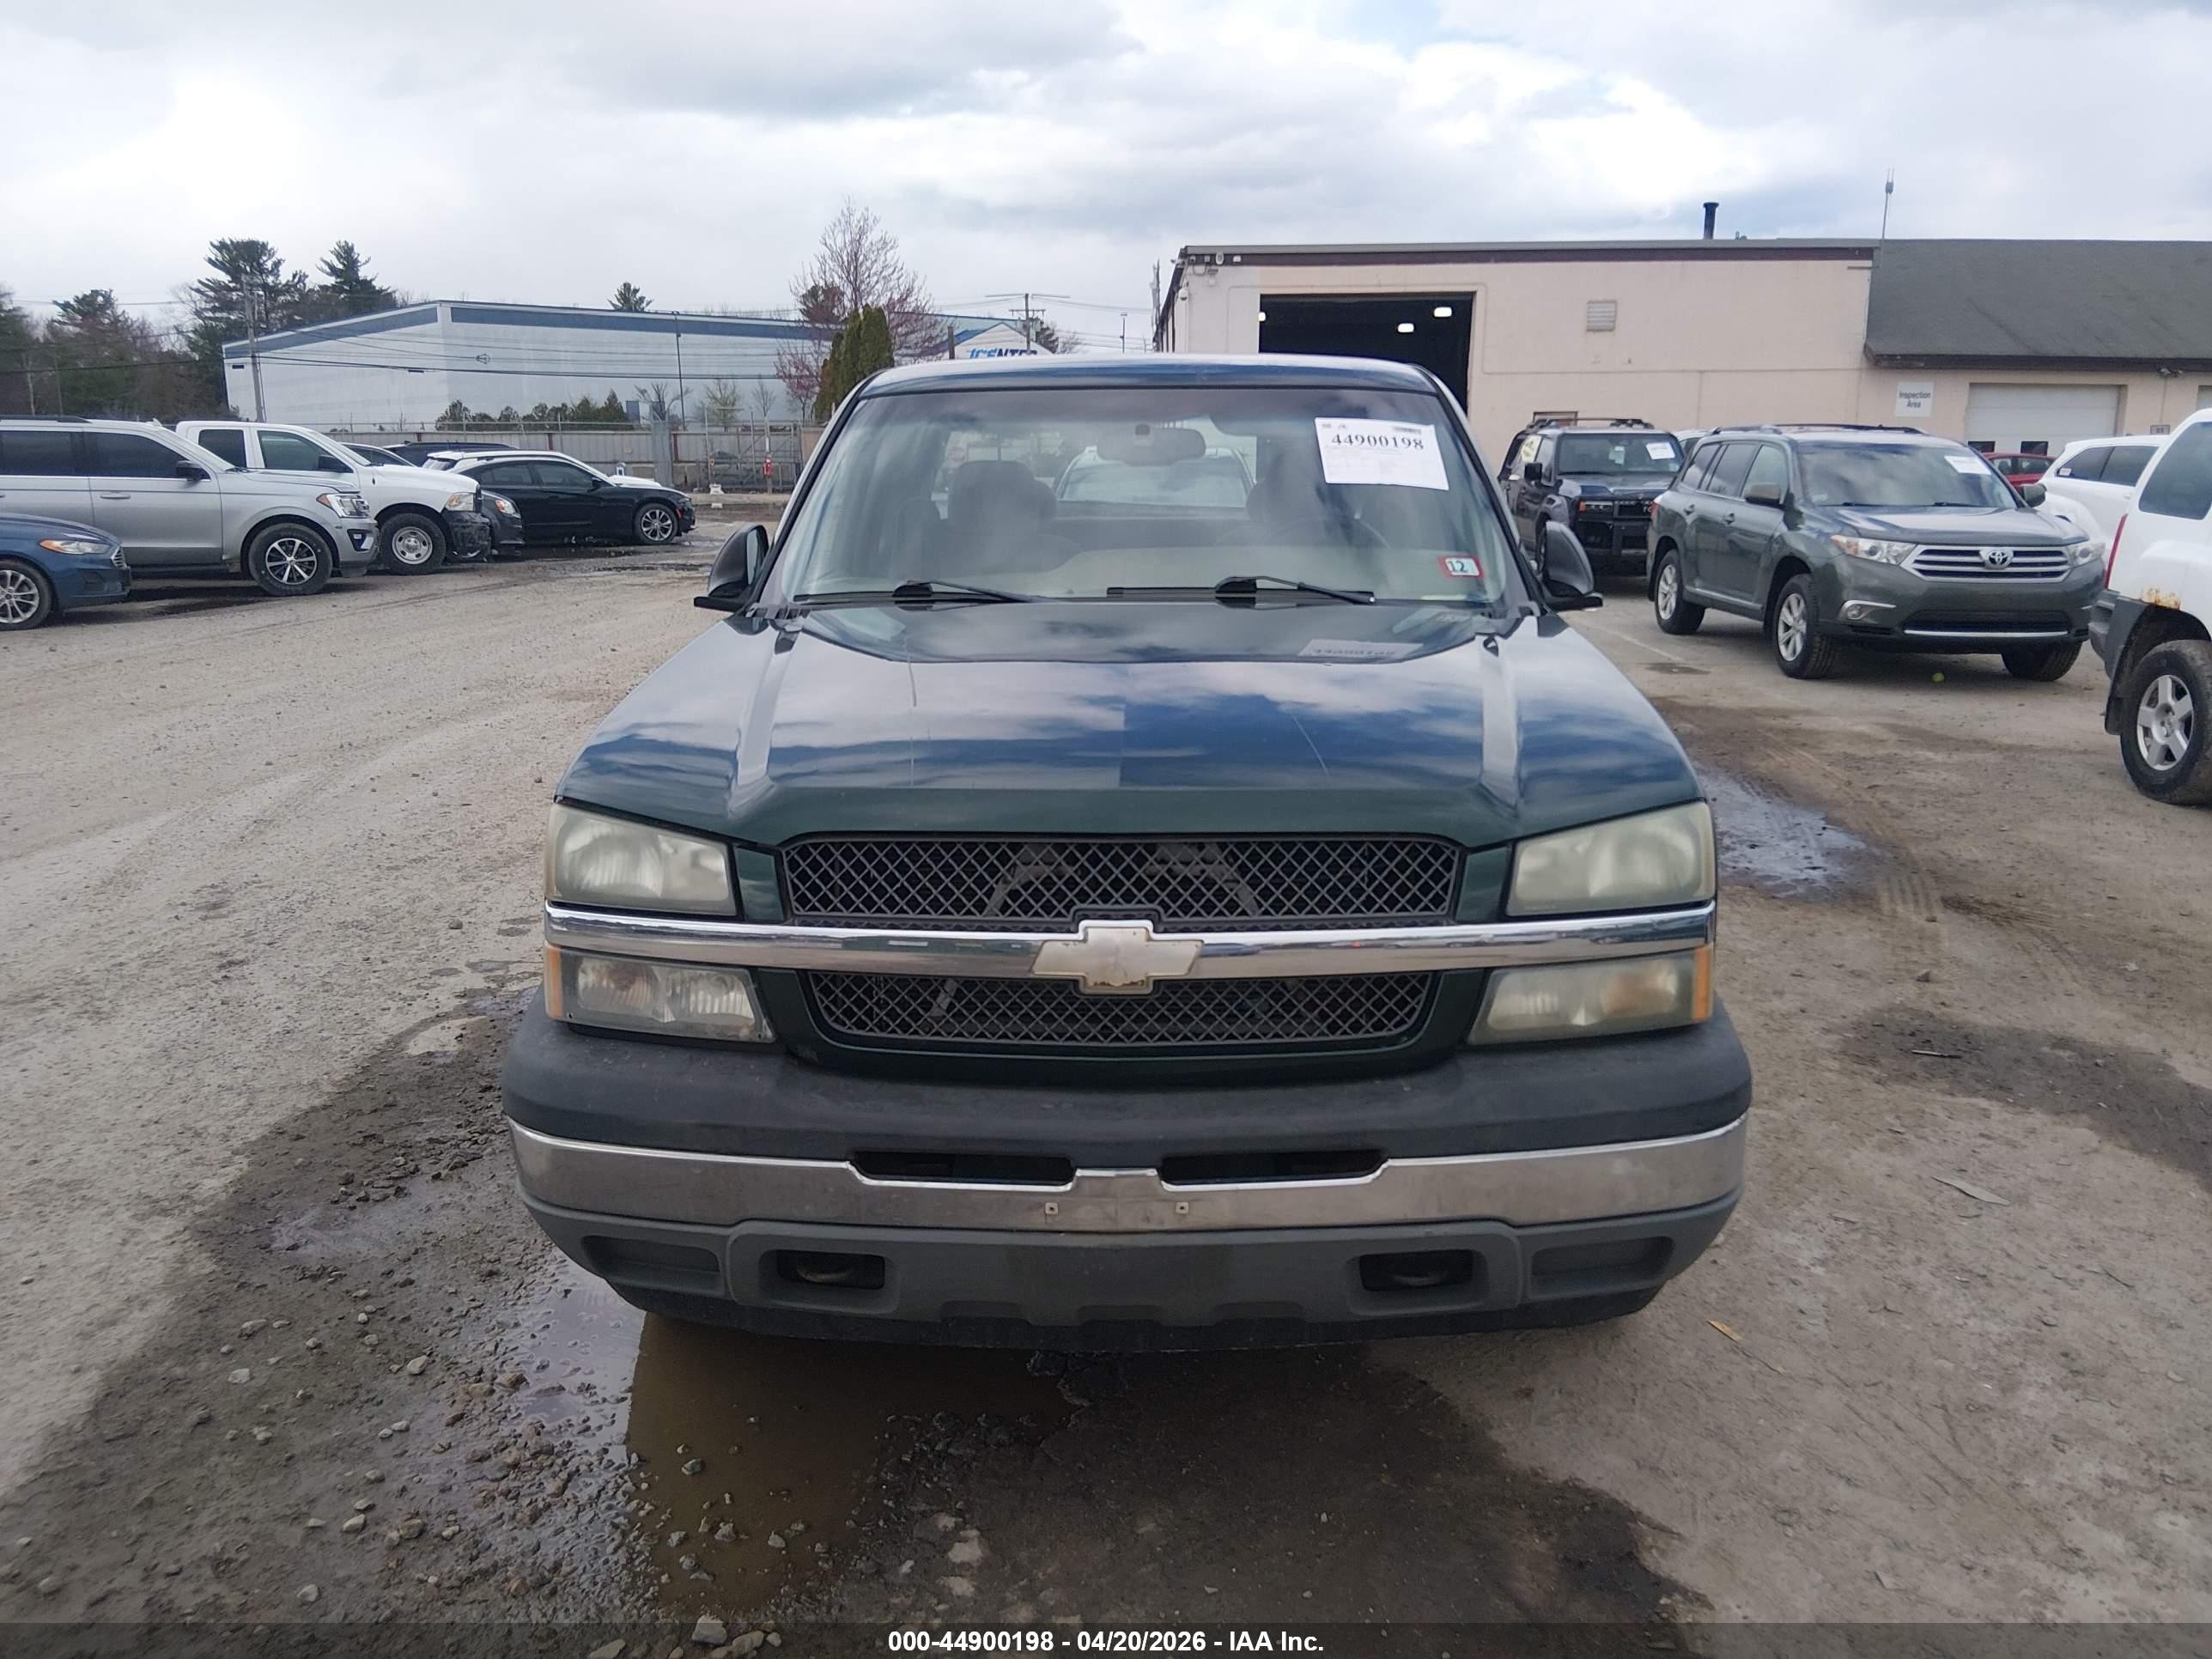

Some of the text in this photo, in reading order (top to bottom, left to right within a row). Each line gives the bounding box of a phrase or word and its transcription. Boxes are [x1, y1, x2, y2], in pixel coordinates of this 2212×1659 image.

[1899, 391, 1931, 399] Inspection
[1906, 400, 1921, 409] Area
[1331, 434, 1425, 451] 44900198
[1448, 560, 1469, 574] 12
